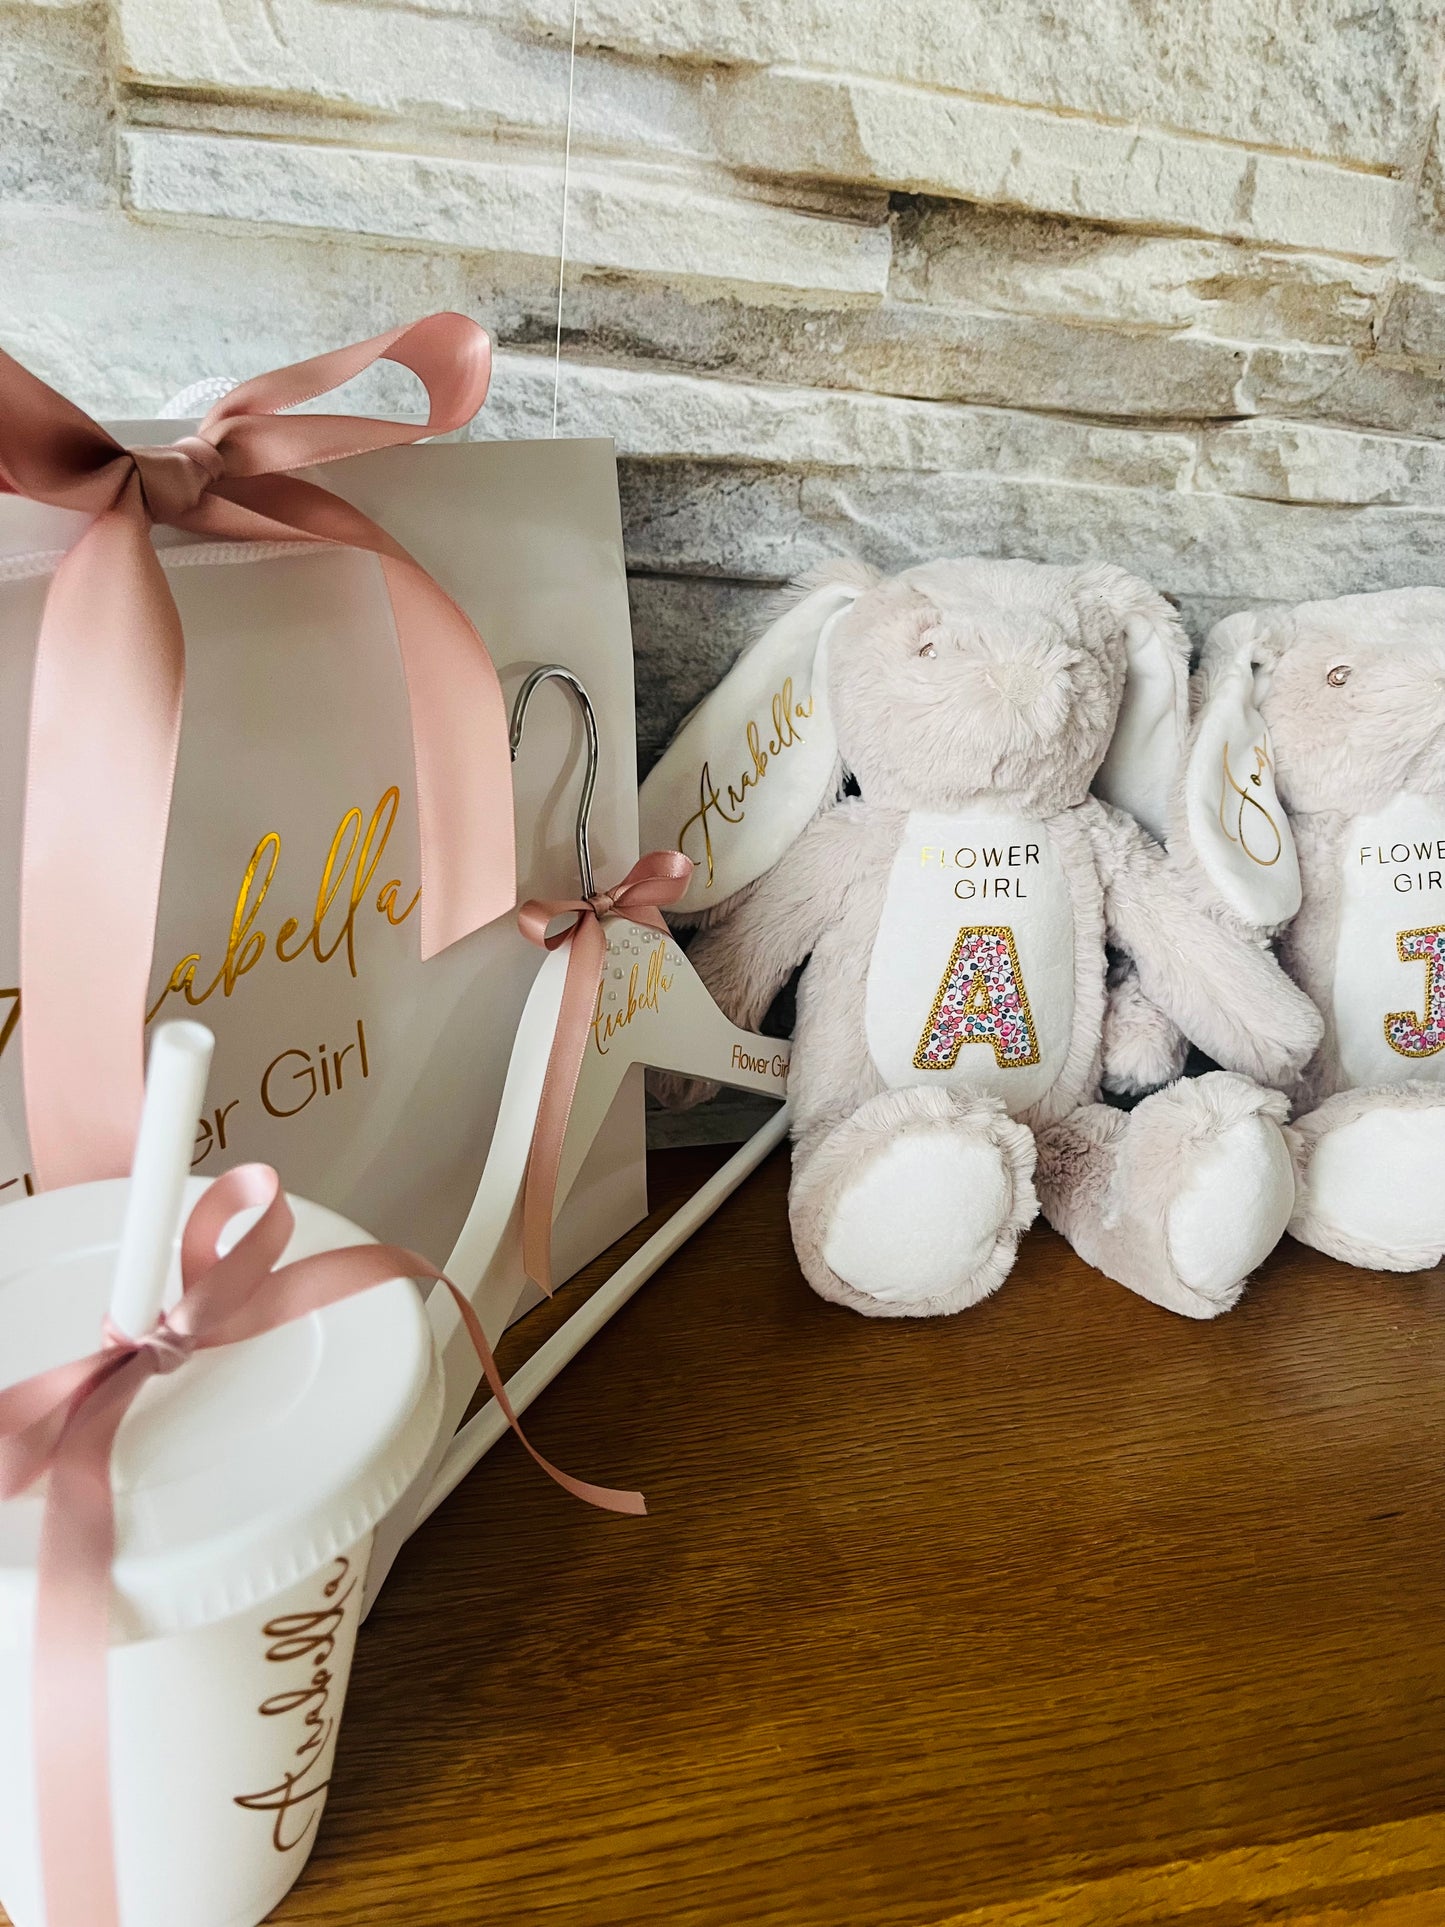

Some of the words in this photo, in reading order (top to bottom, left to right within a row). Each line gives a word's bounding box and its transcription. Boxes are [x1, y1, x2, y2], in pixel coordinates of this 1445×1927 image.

[680, 677, 814, 888] Arabella
[145, 786, 421, 1025] abella
[919, 844, 1040, 869] FLOWER
[954, 878, 1028, 899] GIRL
[912, 926, 1041, 1069] A
[260, 1020, 369, 1117] Girl
[731, 1044, 770, 1074] Flower
[233, 1556, 358, 1852] Arabella
